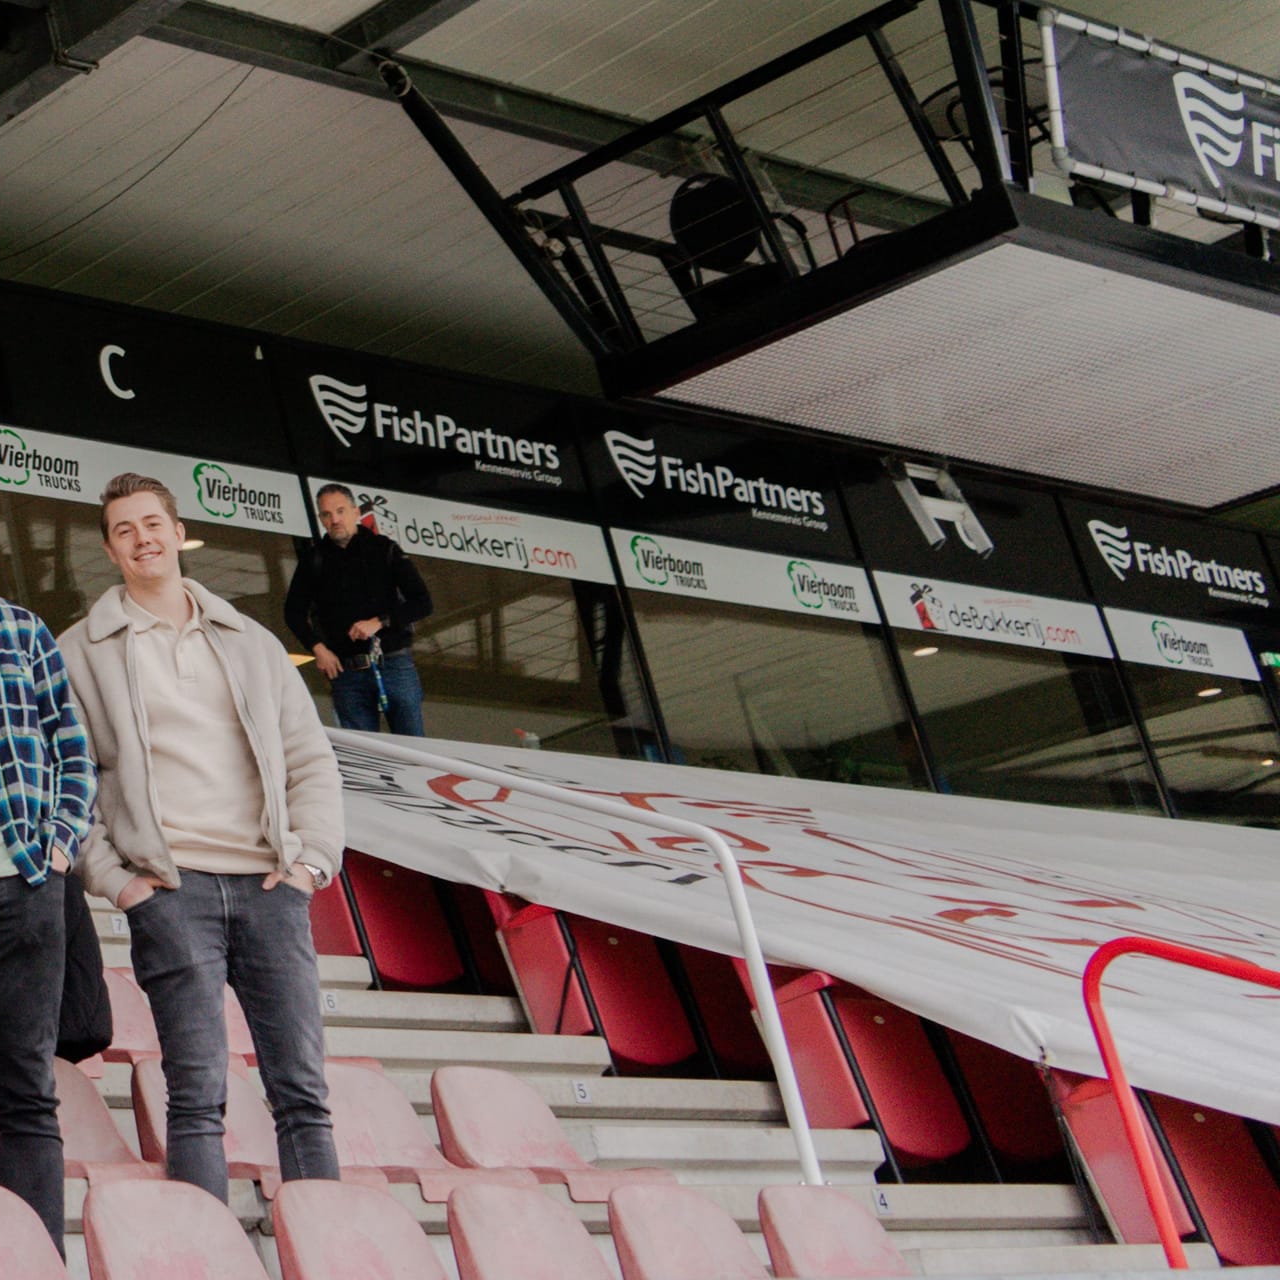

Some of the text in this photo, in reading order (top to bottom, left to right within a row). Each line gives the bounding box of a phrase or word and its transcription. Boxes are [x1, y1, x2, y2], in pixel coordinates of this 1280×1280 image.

[99, 344, 136, 399] C
[373, 403, 561, 470] FishPartners
[37, 473, 81, 492] TRUCKS
[205, 477, 281, 510] Vierboom
[661, 456, 826, 516] FishPartners
[243, 506, 284, 524] TRUCKS
[404, 519, 577, 569] deBakkerij.com
[641, 548, 704, 577] Vierboom
[1133, 541, 1266, 594] FishPartners
[674, 574, 708, 591] TRUCKS
[796, 573, 856, 600] Vierboom
[948, 602, 1081, 646] deBakkerij.com
[1160, 632, 1209, 655] Vierboom
[114, 917, 123, 932] 7
[326, 994, 336, 1009] 6
[576, 1083, 587, 1099] 5
[879, 1192, 889, 1210] 4
